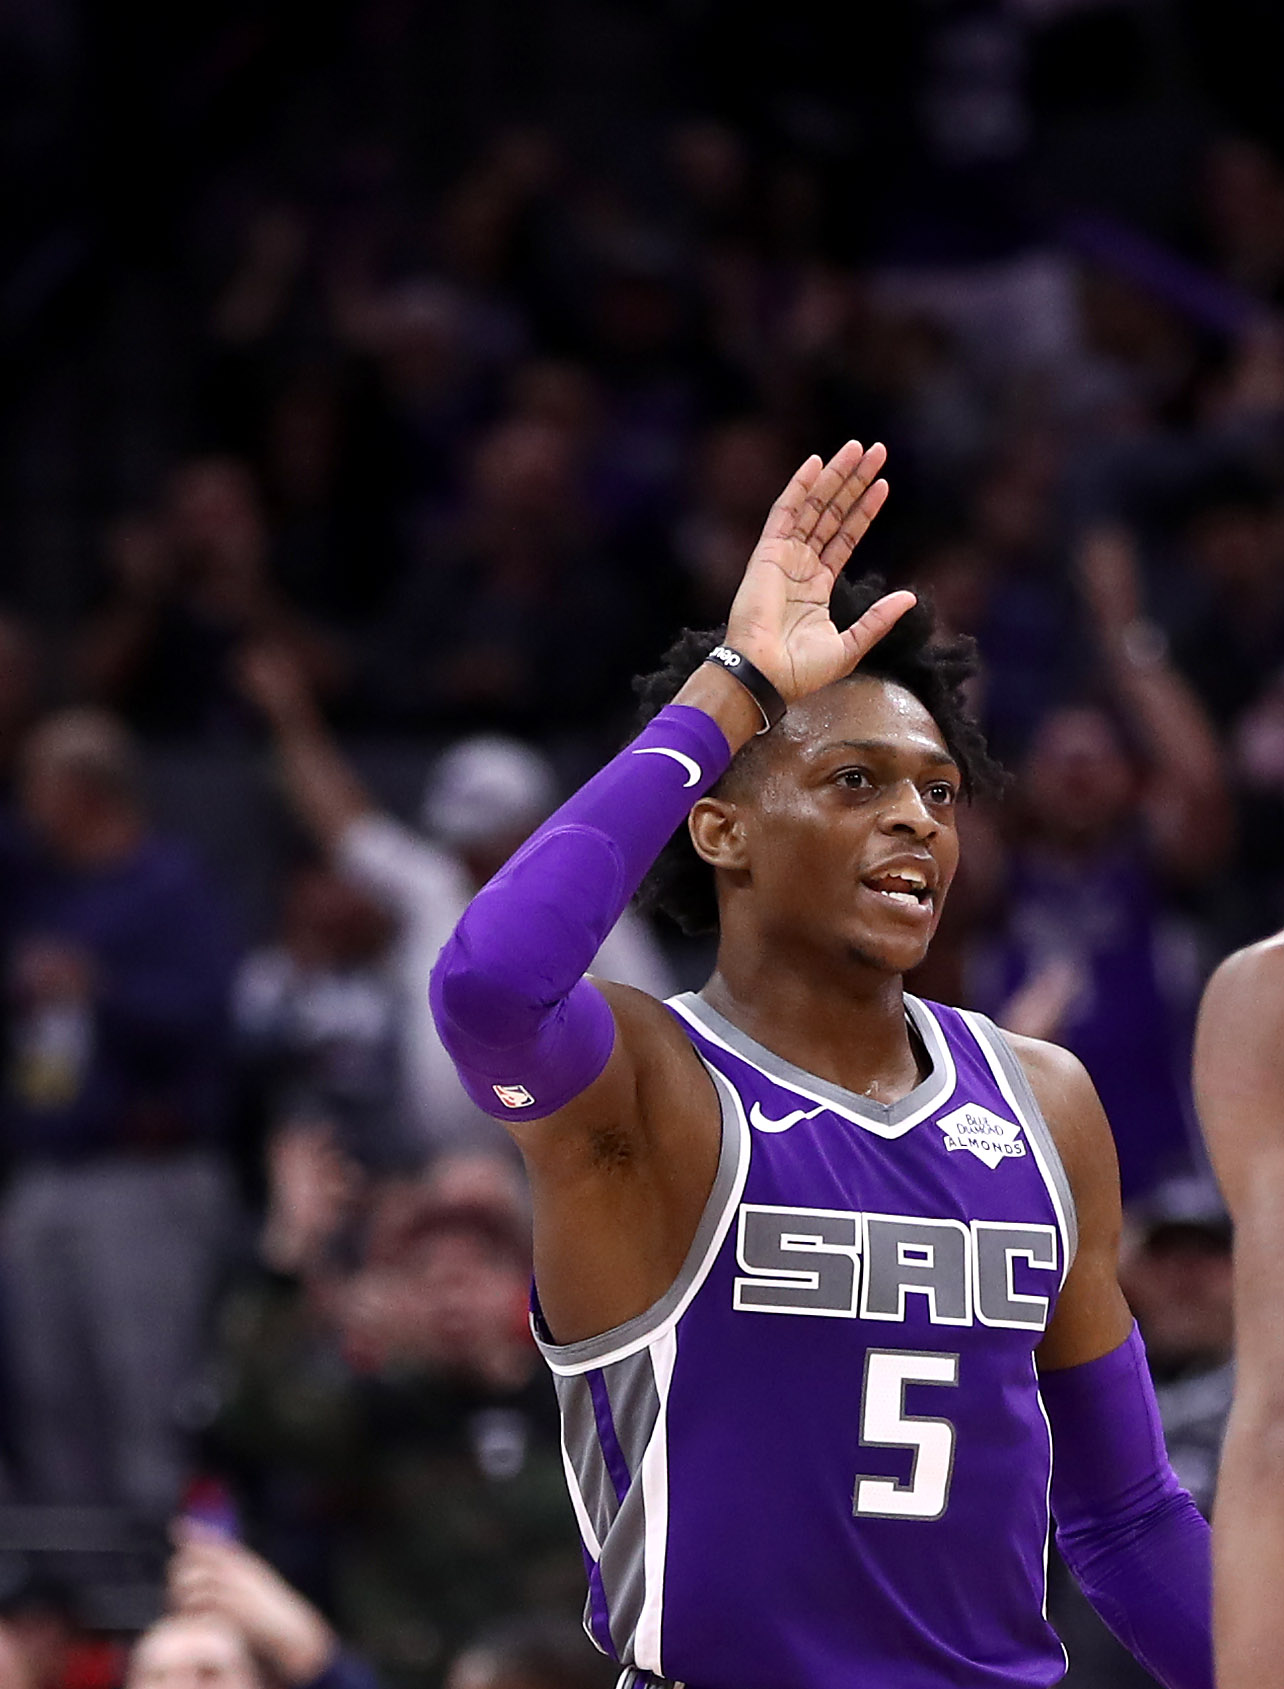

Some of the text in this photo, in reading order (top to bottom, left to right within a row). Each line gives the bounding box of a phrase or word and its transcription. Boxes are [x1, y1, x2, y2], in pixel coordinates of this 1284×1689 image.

[948, 1137, 1022, 1154] ALMONDS
[733, 1203, 1057, 1331] SAC
[852, 1347, 960, 1522] 5
